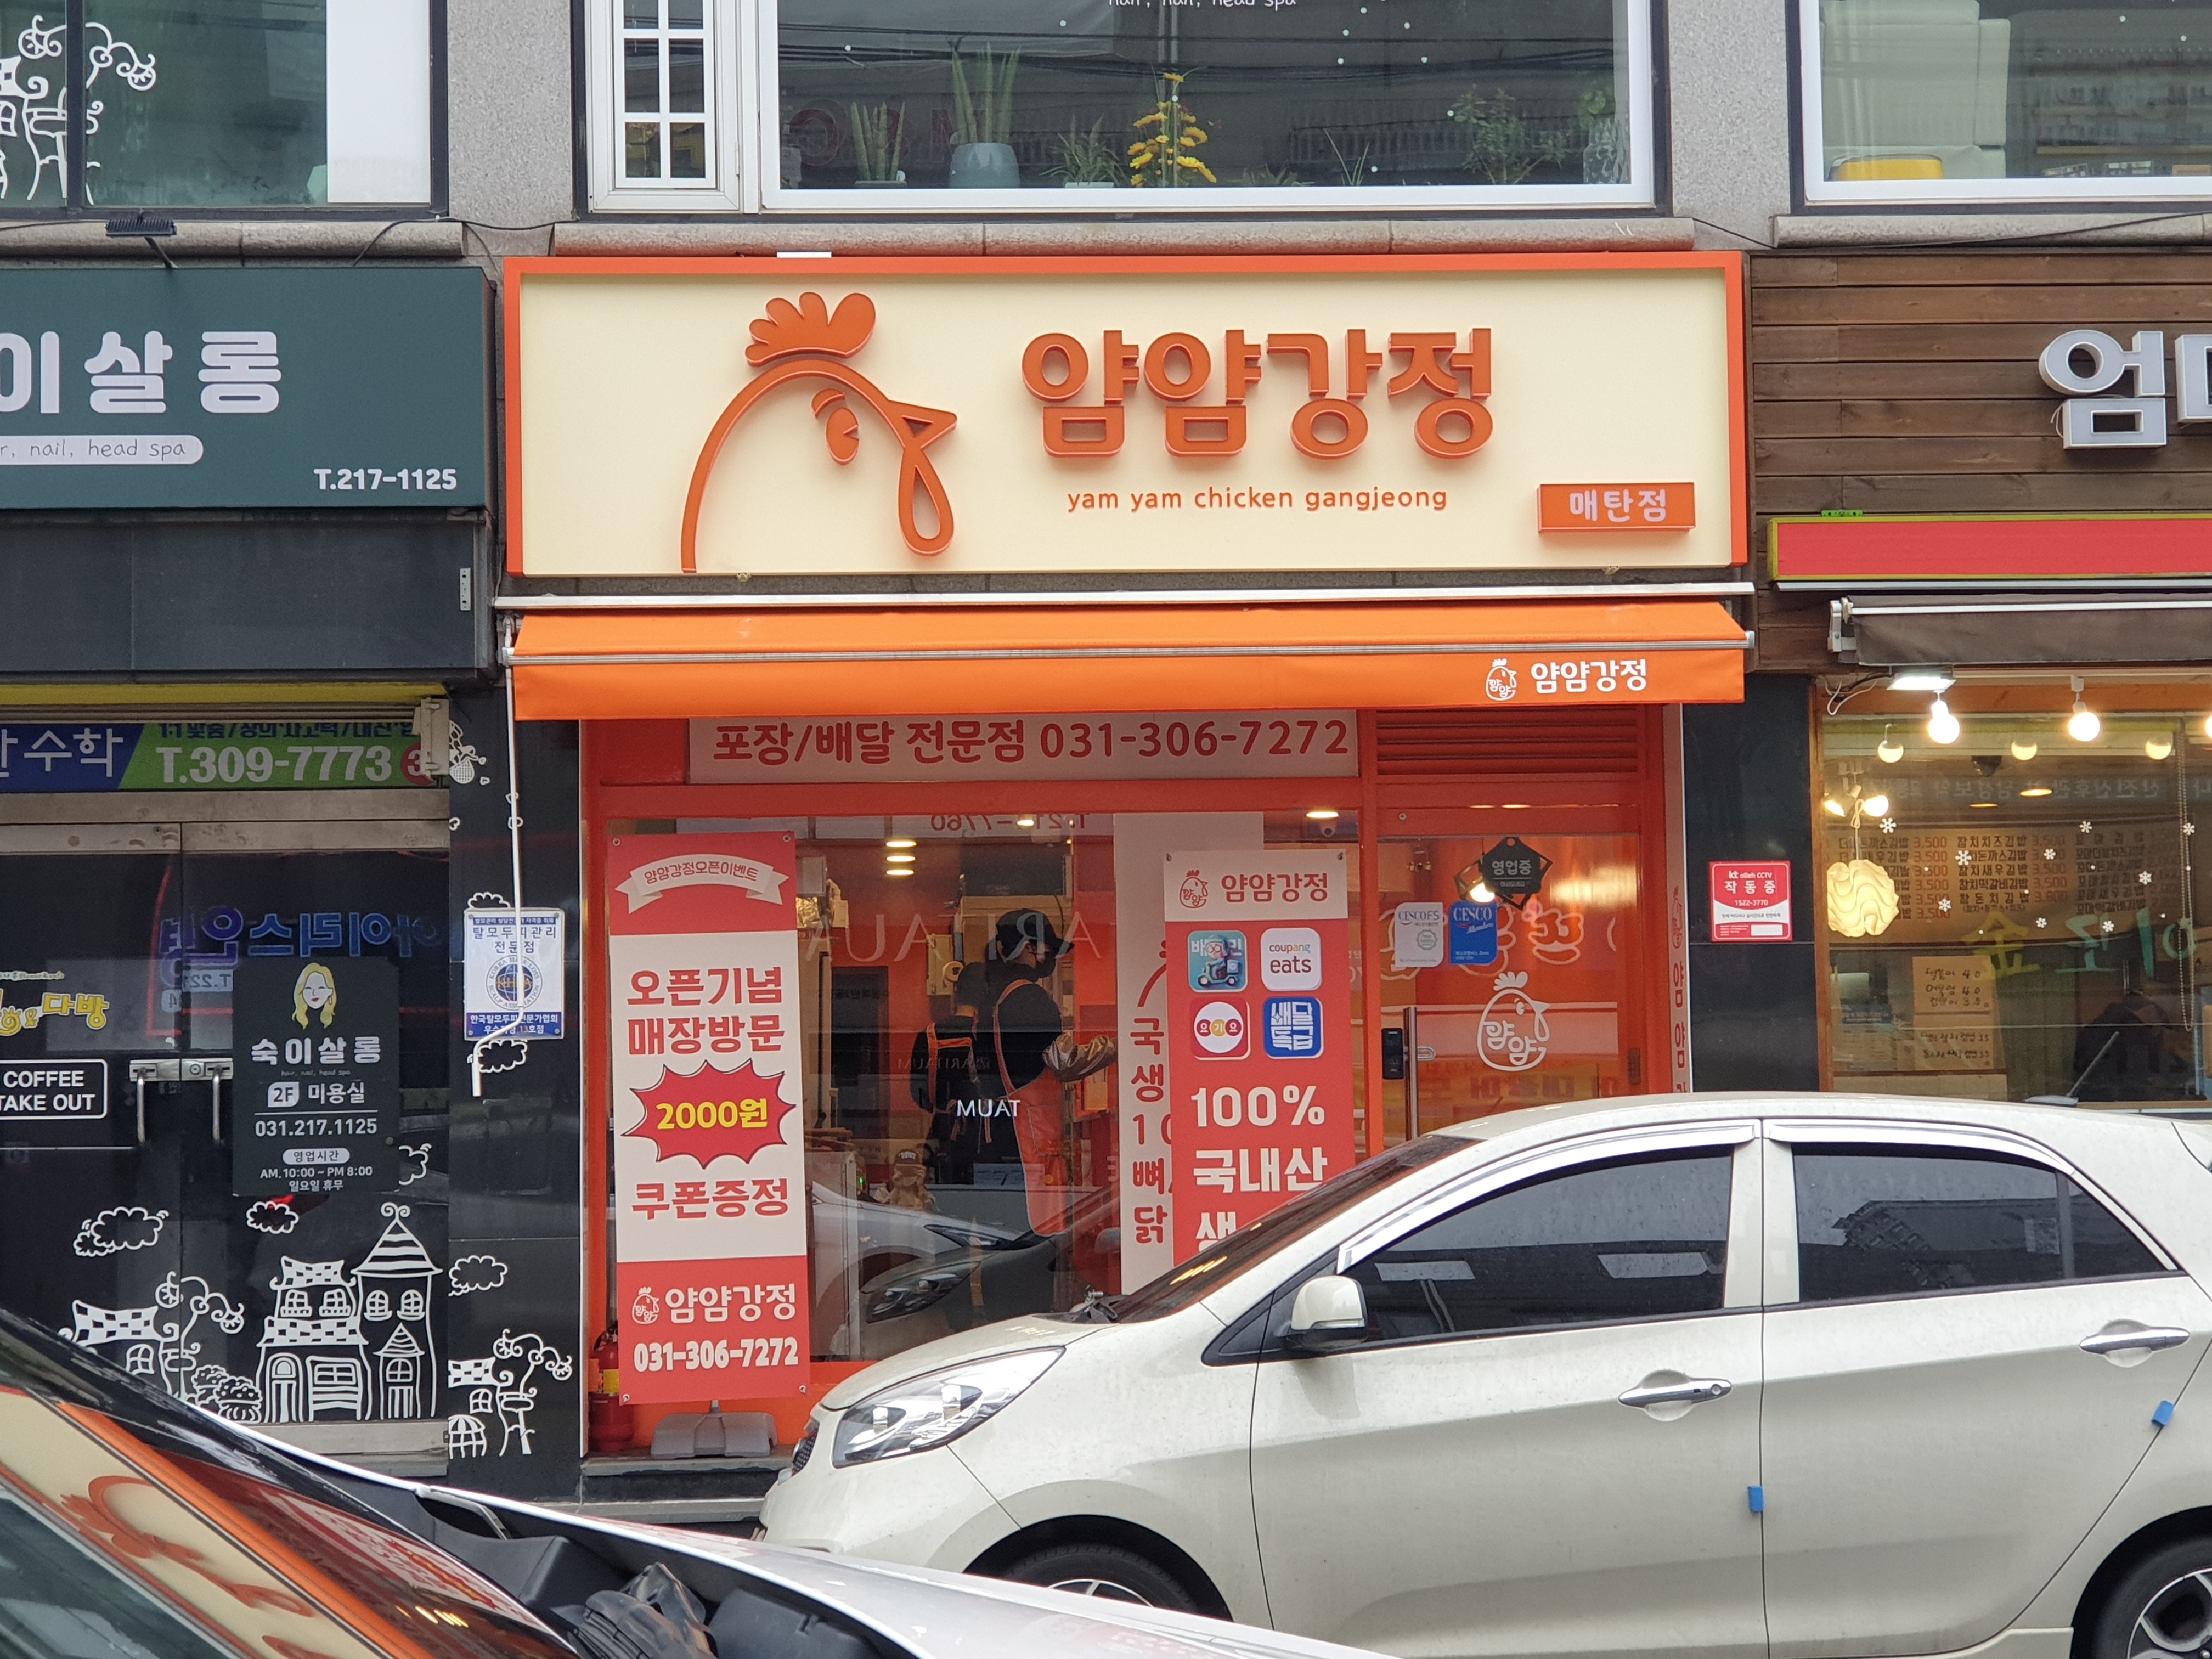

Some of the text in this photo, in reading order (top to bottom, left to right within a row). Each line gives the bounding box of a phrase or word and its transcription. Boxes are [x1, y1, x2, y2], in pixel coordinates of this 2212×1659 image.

[1022, 328, 1493, 459] 얌얌강정
[30, 439, 74, 458] nail,
[88, 439, 138, 456] head
[149, 442, 185, 460] spa
[313, 468, 458, 490] T.217-1125
[1068, 486, 1447, 512] yam yam chicken gangjeong
[1570, 489, 1667, 522] 매탄점
[1531, 659, 1647, 693] 얌얌강정
[713, 719, 1349, 766] 포장/배달 전문점 031-306-7272
[156, 746, 392, 783] T.309-7773
[1914, 836, 1947, 848] 3.500
[1914, 851, 1948, 862] 3.500
[1492, 860, 1531, 876] 영업중
[1729, 871, 1739, 879] kt
[1221, 873, 1328, 902] 얌얌강정
[1454, 907, 1492, 921] CESCO
[1269, 944, 1310, 953] coupang
[1270, 956, 1311, 974] eats
[627, 967, 782, 1006] 오픈기념
[42, 995, 109, 1028] 다방
[627, 1015, 785, 1055] 매장방문
[1200, 1023, 1238, 1032] 요기요
[251, 1036, 381, 1065] 숙이살롱
[3, 1071, 84, 1088] COFFEE
[53, 1094, 95, 1111] OUT
[273, 1087, 294, 1103] 2F
[308, 1082, 365, 1104] 미용실
[656, 1098, 768, 1130] 2000원
[1191, 1085, 1325, 1127] 100%
[255, 1118, 377, 1137] 031.217.1125
[293, 1150, 339, 1163] 영업시간
[327, 1167, 344, 1177] PM
[347, 1166, 373, 1176] 8:00
[1193, 1147, 1327, 1193] 국내산
[289, 1180, 343, 1192] 일요일 휴무
[632, 1178, 788, 1220] 쿠폰증정
[665, 1284, 795, 1324] 얌얌강정
[634, 1337, 798, 1372] 031-306-7272
